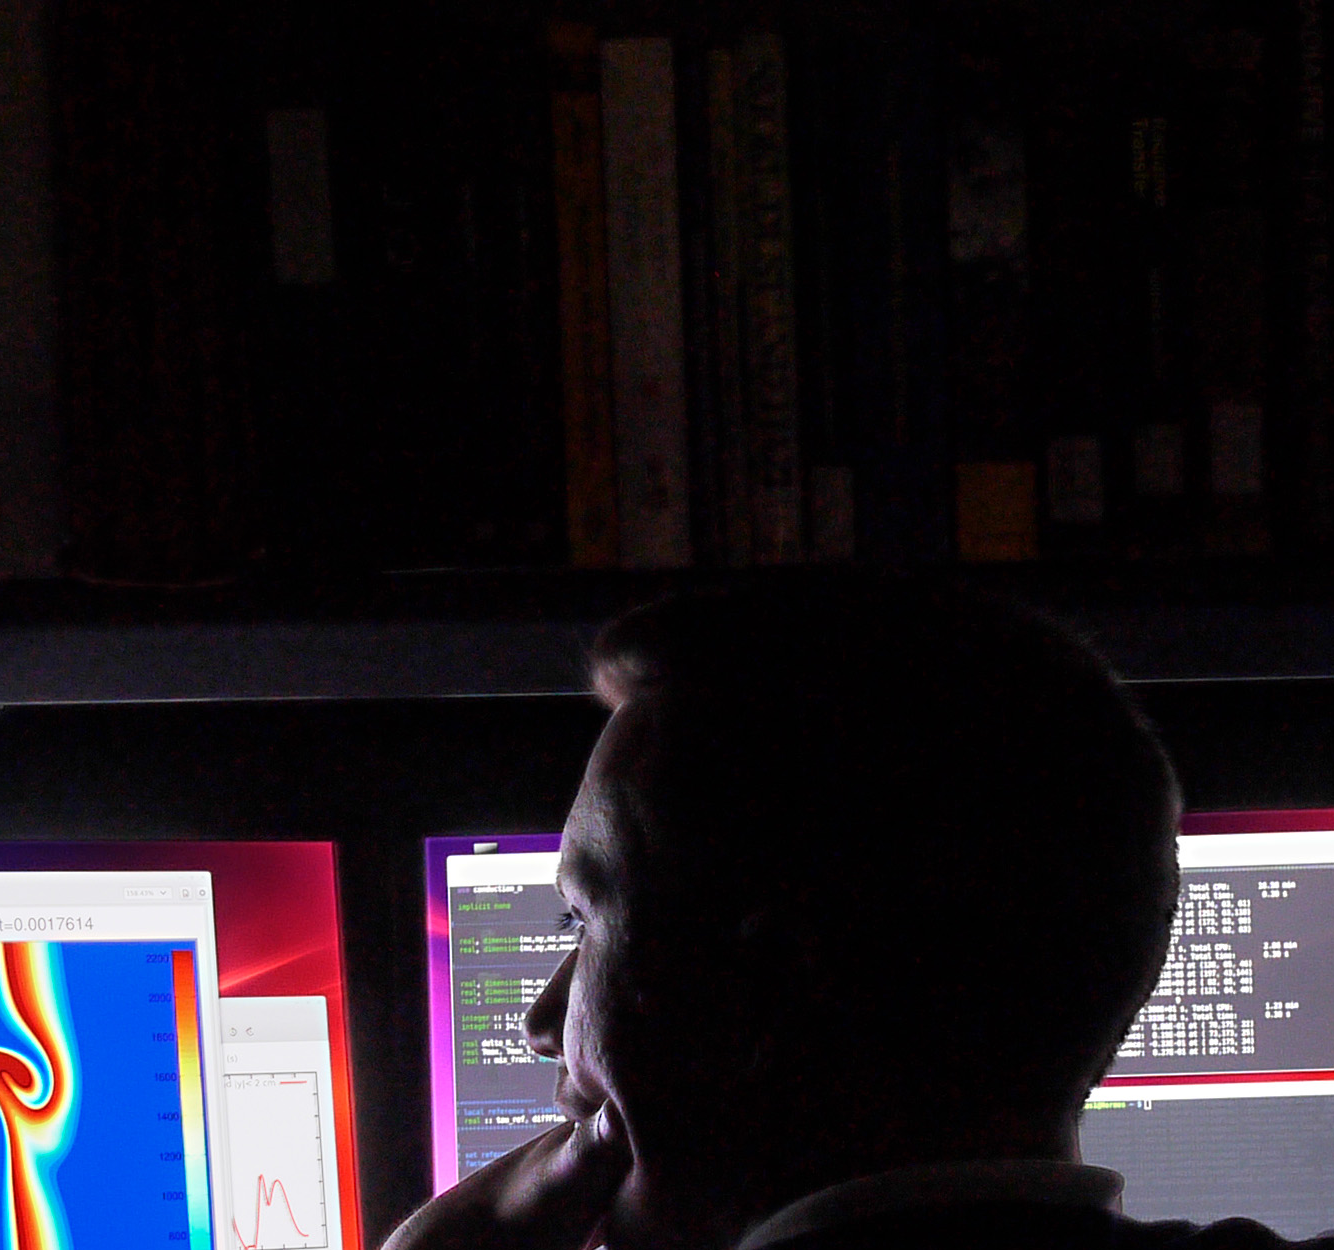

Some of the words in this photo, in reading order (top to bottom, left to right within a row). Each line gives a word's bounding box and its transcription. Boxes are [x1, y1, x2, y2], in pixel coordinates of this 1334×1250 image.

[1188, 883, 1210, 892] Total
[1188, 891, 1210, 900] Total
[0, 916, 94, 932] t=0.0017614
[146, 953, 170, 963] 2200
